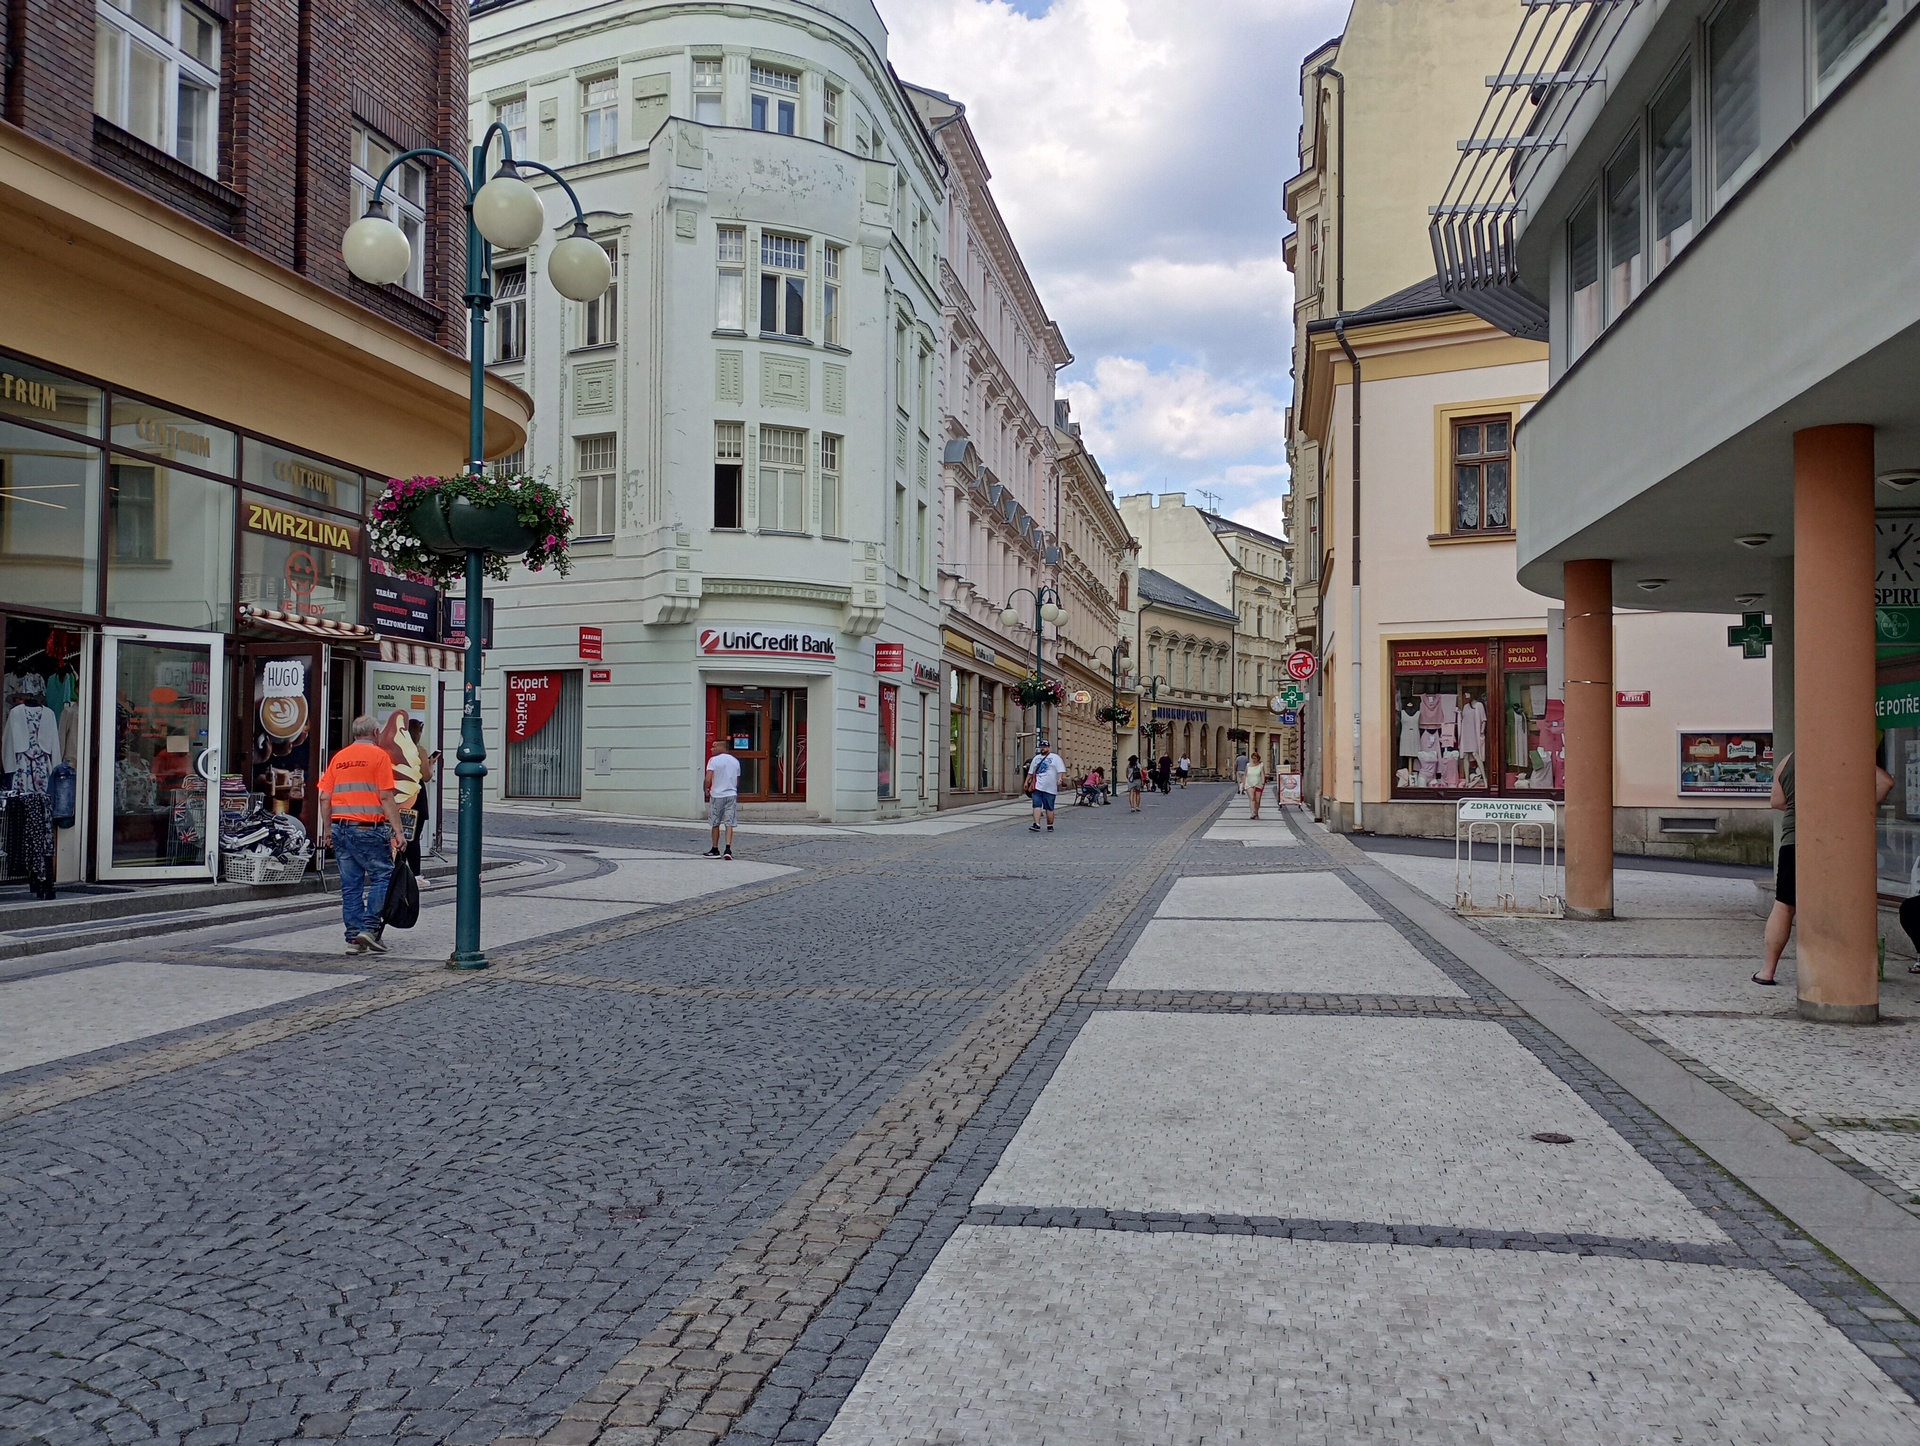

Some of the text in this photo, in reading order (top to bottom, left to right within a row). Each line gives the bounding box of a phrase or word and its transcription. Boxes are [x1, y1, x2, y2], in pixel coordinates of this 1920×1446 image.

[2, 373, 57, 412] TRUM
[137, 417, 211, 458] CENTRUM
[274, 460, 334, 494] CENTRUM
[248, 504, 351, 550] ZMRZLINA
[279, 600, 325, 616] JE TADY
[376, 617, 407, 630] TELEFONNÍ
[723, 631, 835, 654] UniCredit Bank
[1421, 649, 1449, 657] PÁNSKÝ,
[1450, 647, 1479, 656] DÁMSKÝ,
[1397, 656, 1484, 667] DĚTSKÝ, KOJENECKÉ ZBOŽÍ
[268, 667, 299, 687] HUGO
[510, 675, 549, 692] Expert
[525, 693, 536, 701] na
[1621, 693, 1645, 702] ANENSKÁ
[1886, 693, 1920, 716] POTŘE
[514, 693, 528, 736] půjčky
[1470, 802, 1543, 811] ZDRAVOTNICKÉ
[1485, 811, 1528, 819] POTŘEBY
